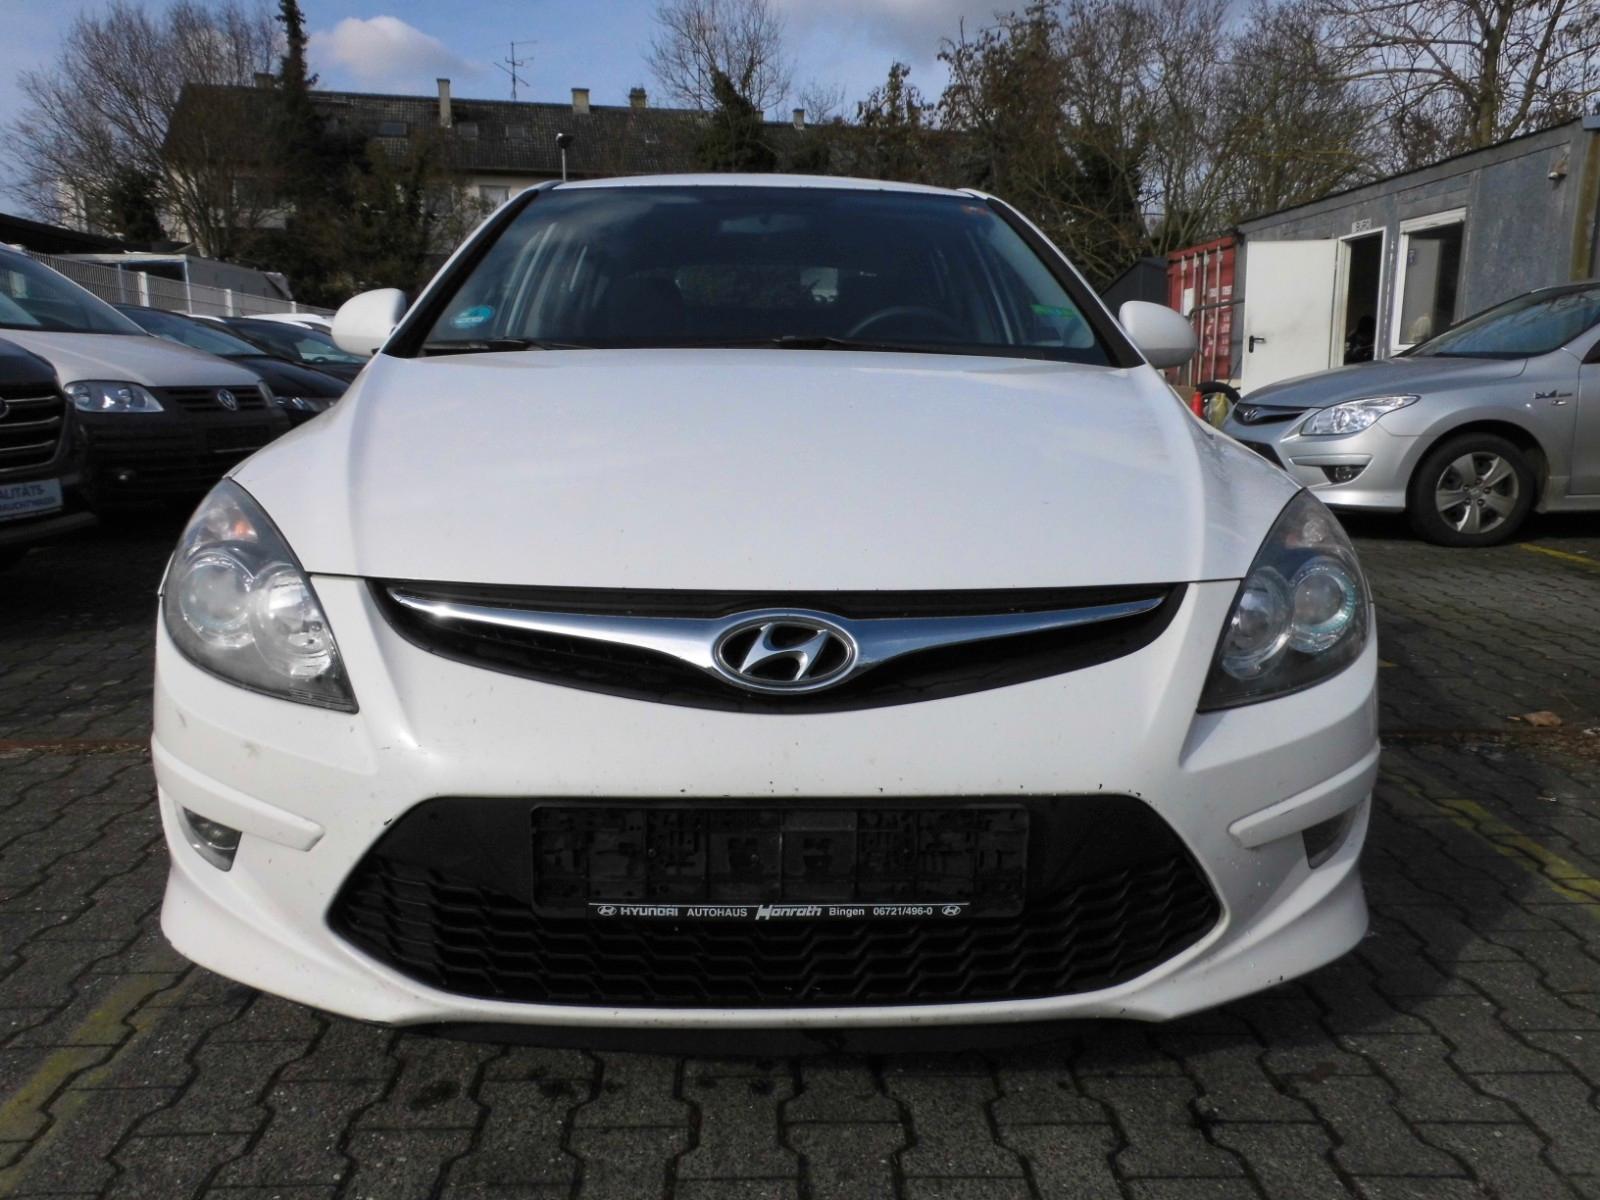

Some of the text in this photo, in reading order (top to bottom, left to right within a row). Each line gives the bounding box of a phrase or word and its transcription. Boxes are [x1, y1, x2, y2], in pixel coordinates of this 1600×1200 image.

[620, 906, 679, 917] HYUNDAI
[687, 907, 748, 917] AUTOHAUS
[829, 907, 865, 918] Bingen
[873, 906, 933, 917] 06721/496-0
